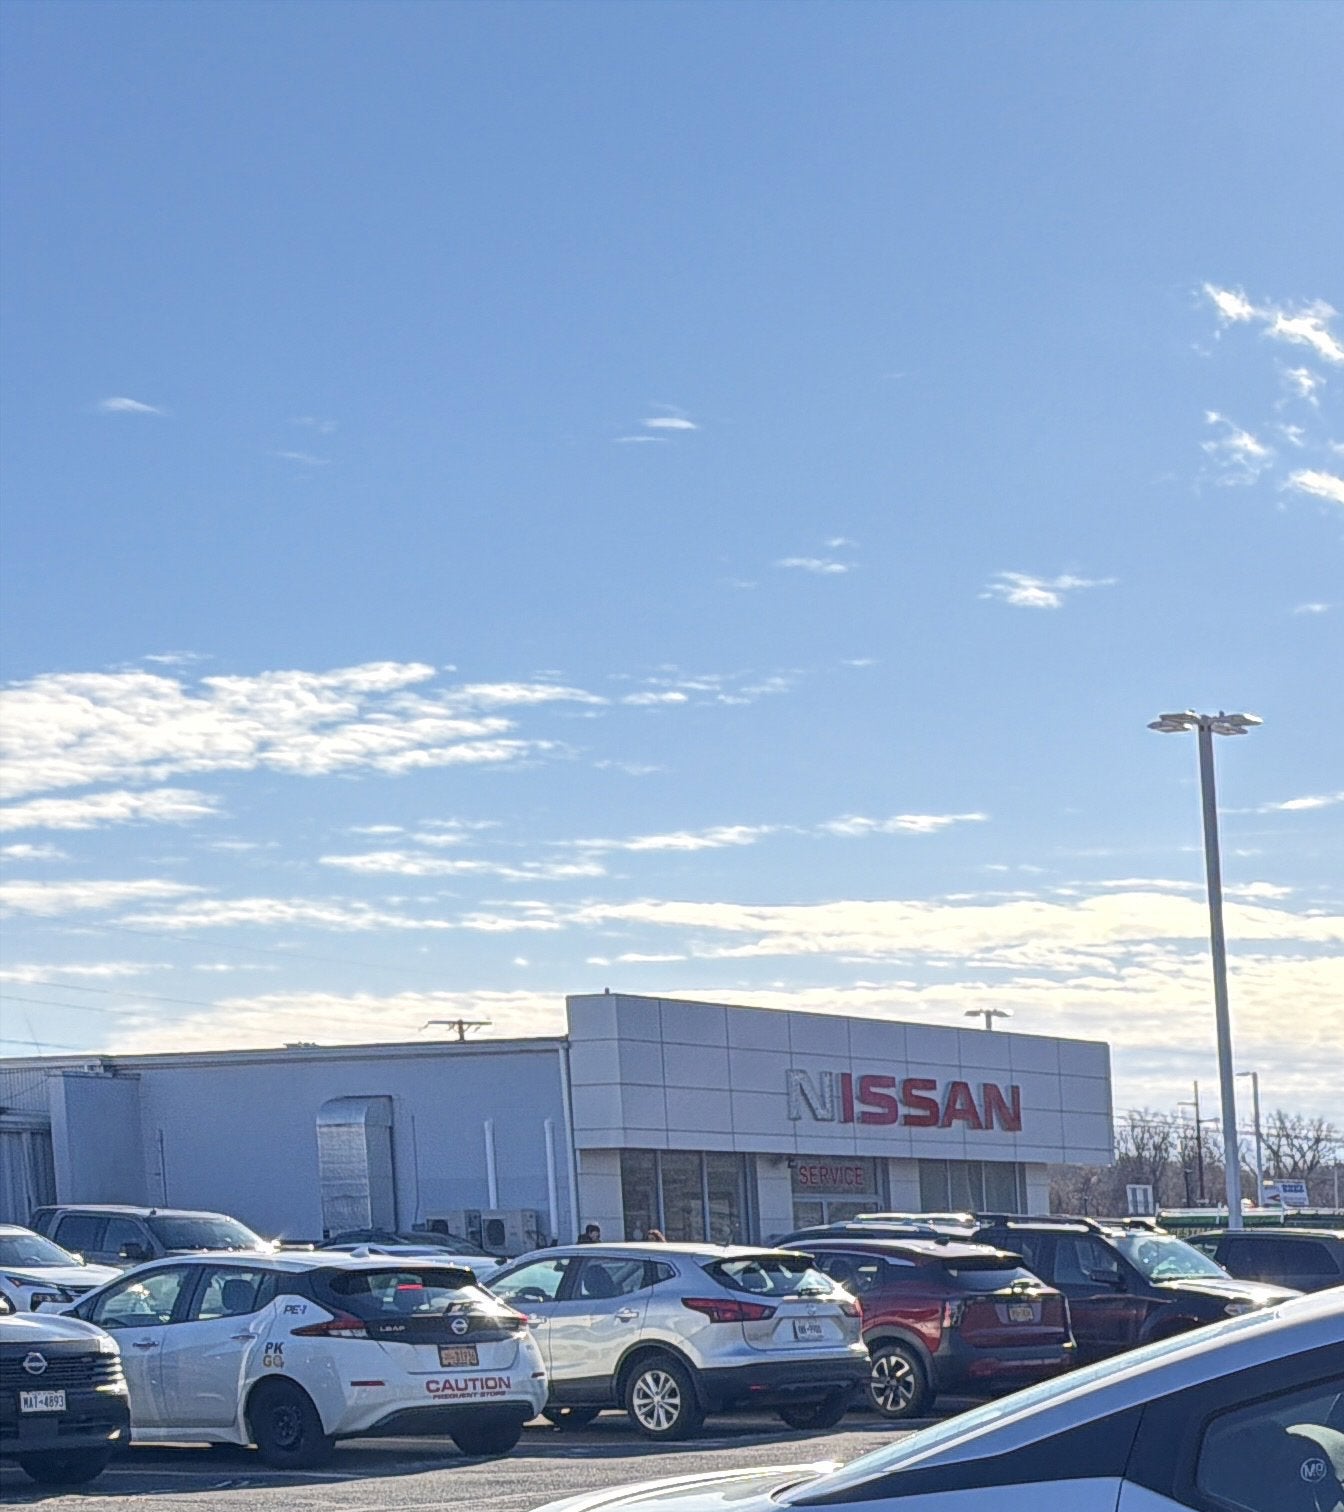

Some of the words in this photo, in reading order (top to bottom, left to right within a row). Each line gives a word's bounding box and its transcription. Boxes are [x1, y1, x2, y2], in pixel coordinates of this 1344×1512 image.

[785, 1068, 1022, 1132] NISSAN
[800, 1165, 864, 1185] SERVICE
[425, 1376, 512, 1394] CAUTION
